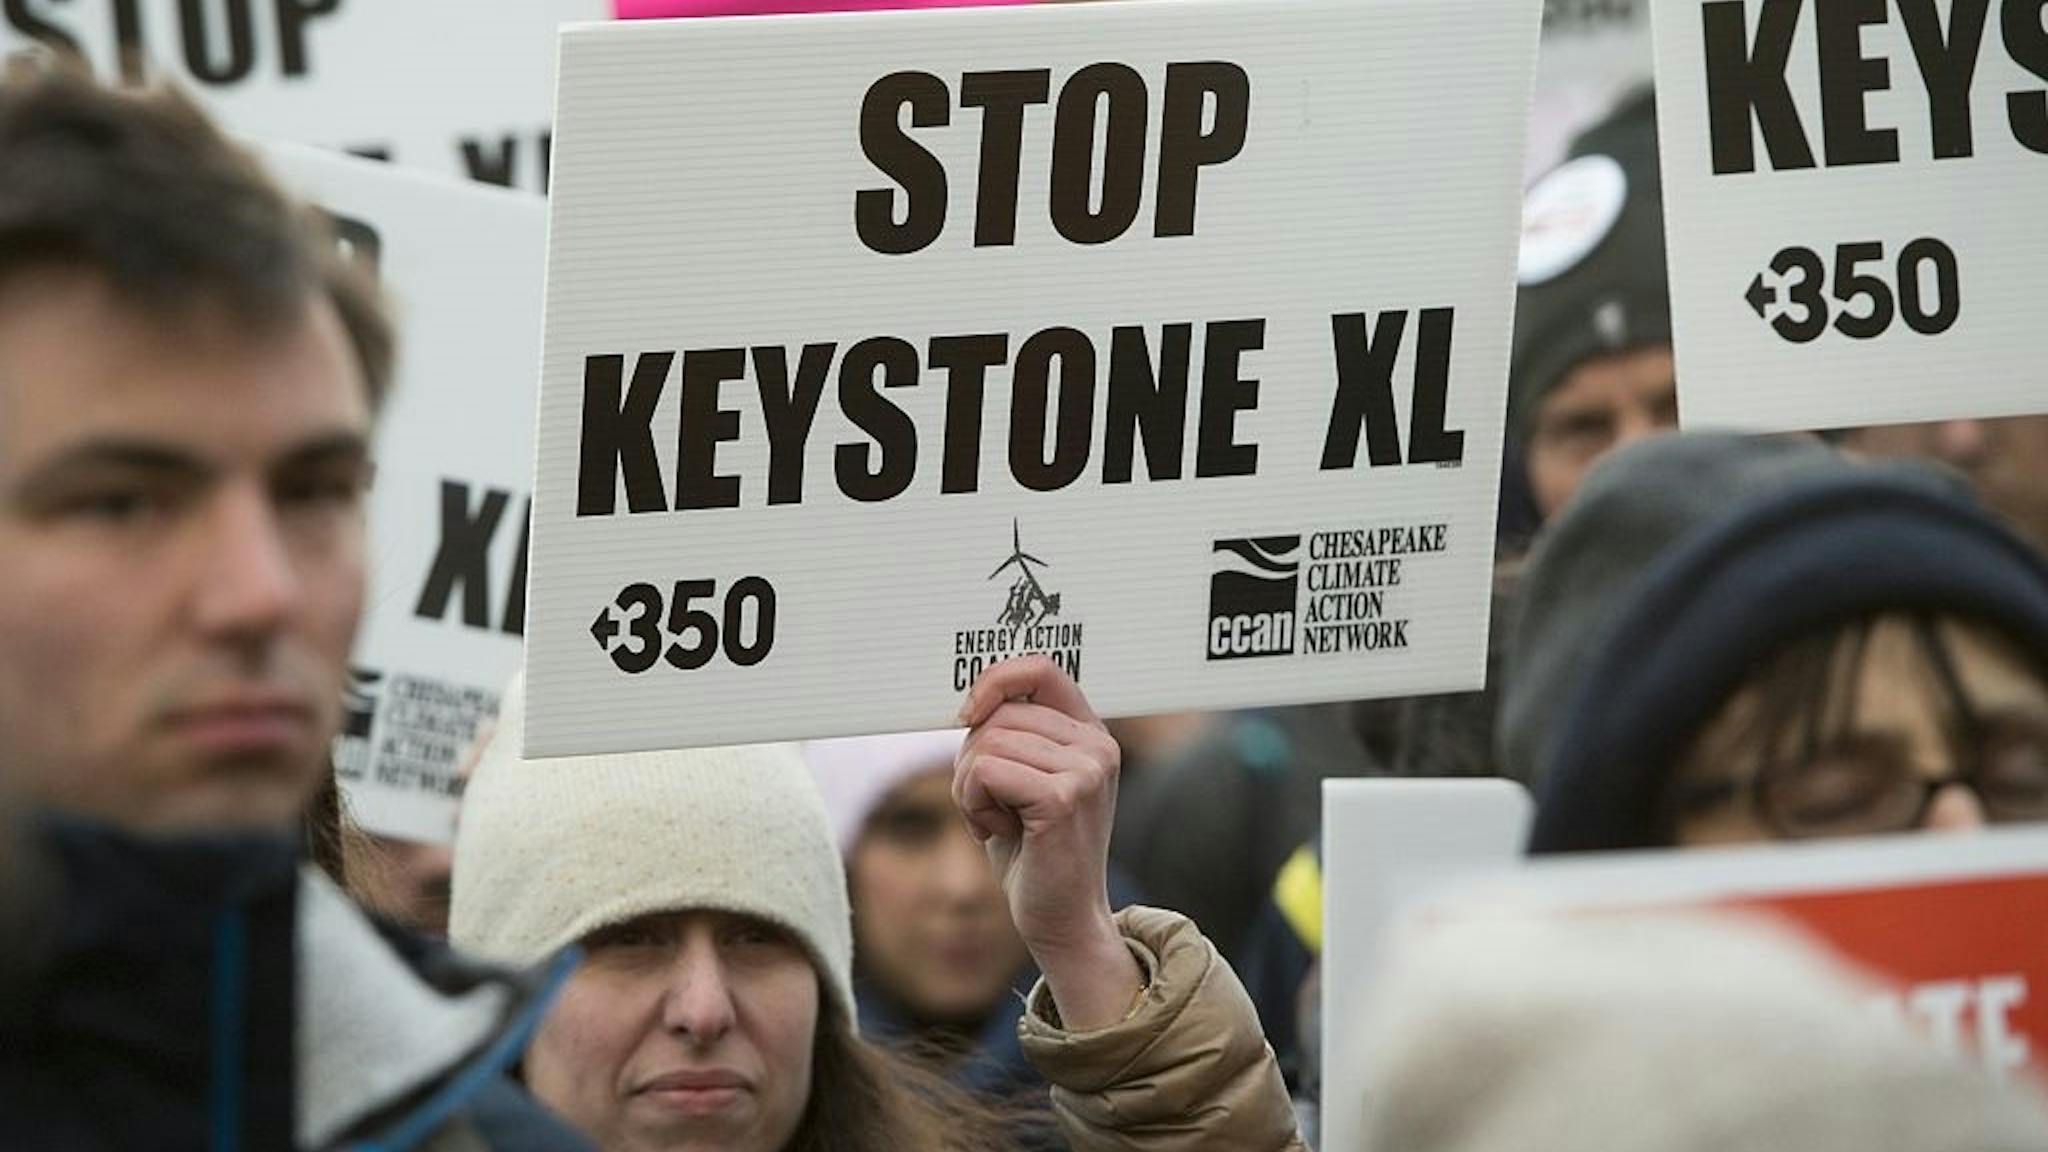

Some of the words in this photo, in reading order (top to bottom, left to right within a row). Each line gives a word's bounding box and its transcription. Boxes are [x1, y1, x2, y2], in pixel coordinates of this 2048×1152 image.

[855, 61, 1250, 256] STOP
[1768, 237, 1961, 344] 350
[576, 317, 1267, 518] KEYSTONE
[1319, 307, 1465, 471] XL
[1309, 524, 1448, 560] CHESAPEAKE
[1306, 558, 1401, 591] CLIMATE
[610, 575, 777, 674] 350
[1304, 590, 1384, 624] ACTION
[955, 625, 1020, 655] ENERGY
[1023, 622, 1082, 650] ACTION
[1210, 610, 1294, 655] ccan
[1303, 620, 1409, 655] NETWORK
